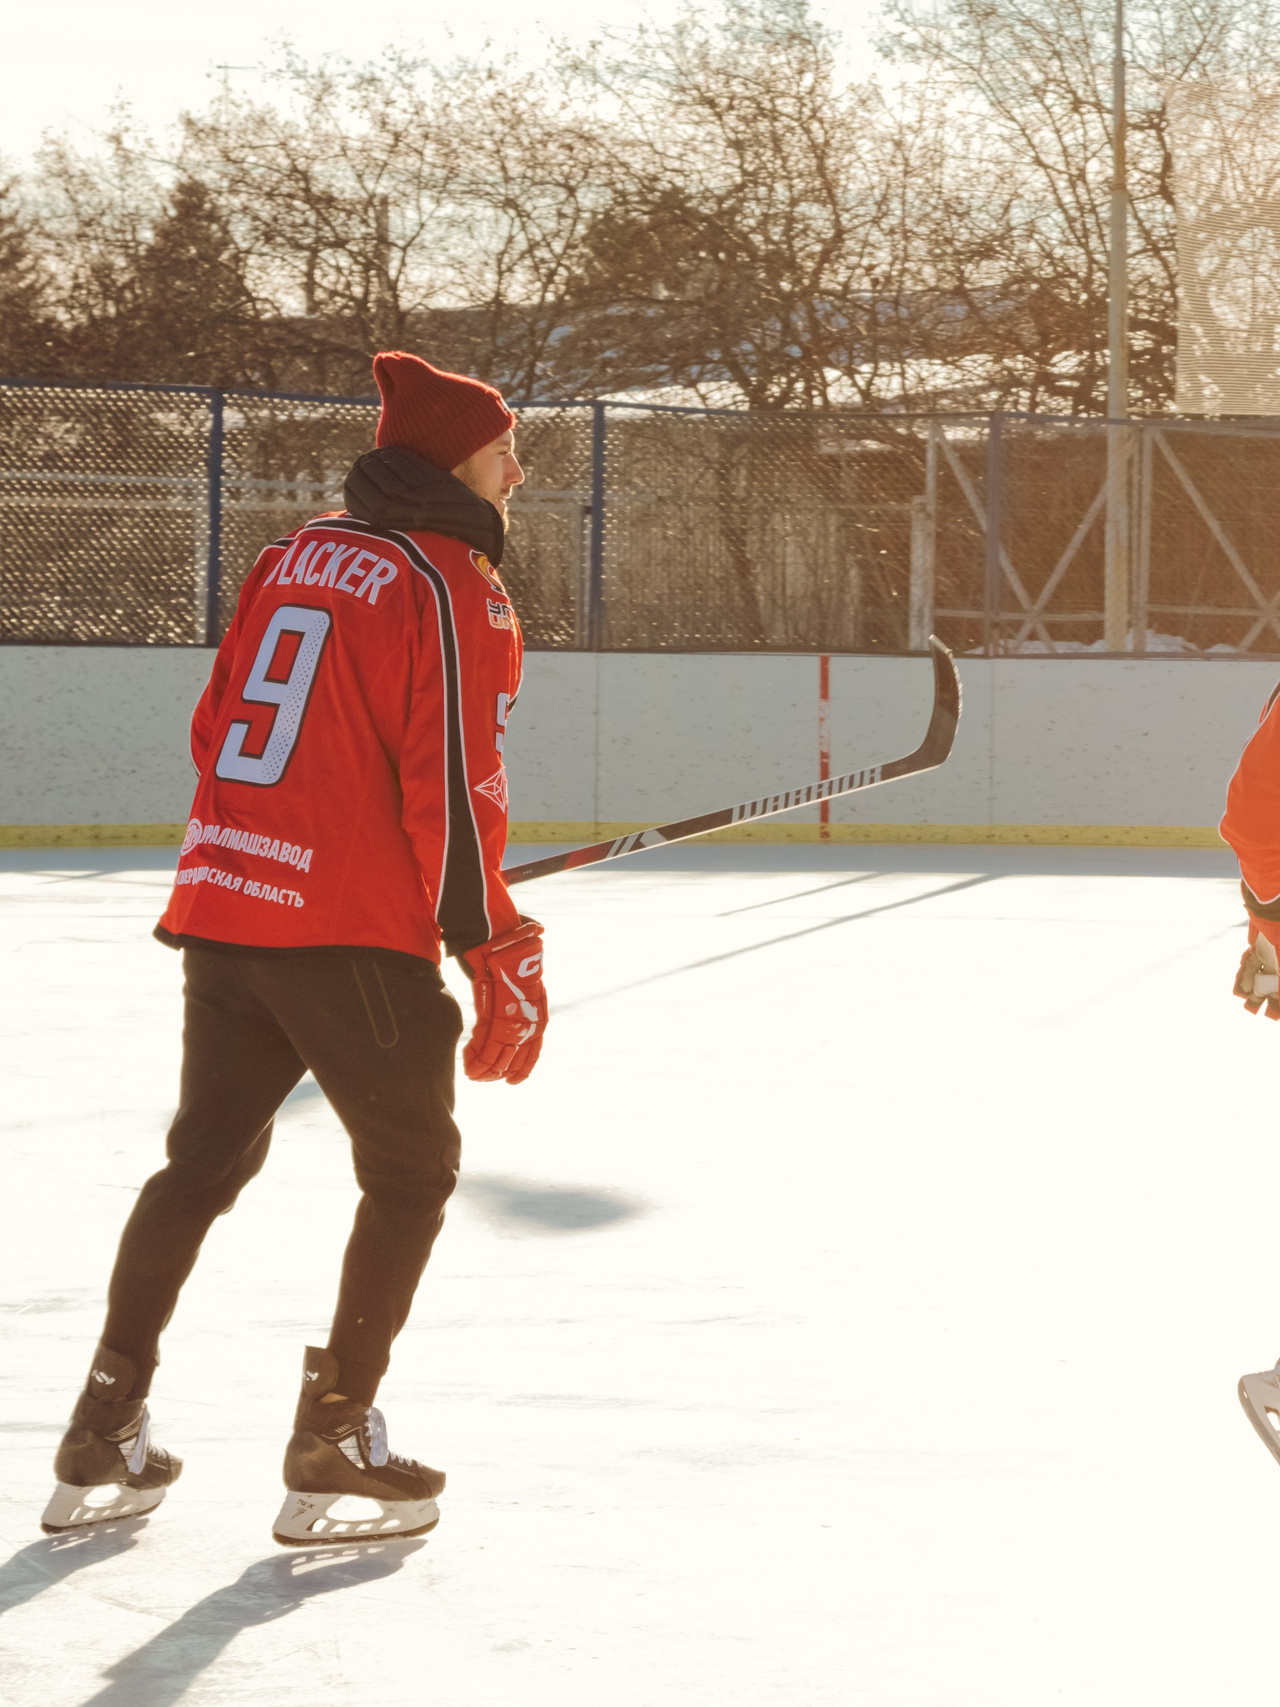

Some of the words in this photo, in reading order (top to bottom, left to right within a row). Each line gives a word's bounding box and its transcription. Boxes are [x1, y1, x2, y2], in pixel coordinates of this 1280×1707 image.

[214, 603, 332, 788] 9
[198, 824, 314, 873] УРАЛМАШЗАВОД
[243, 879, 305, 909] ОБЛАСТЬ
